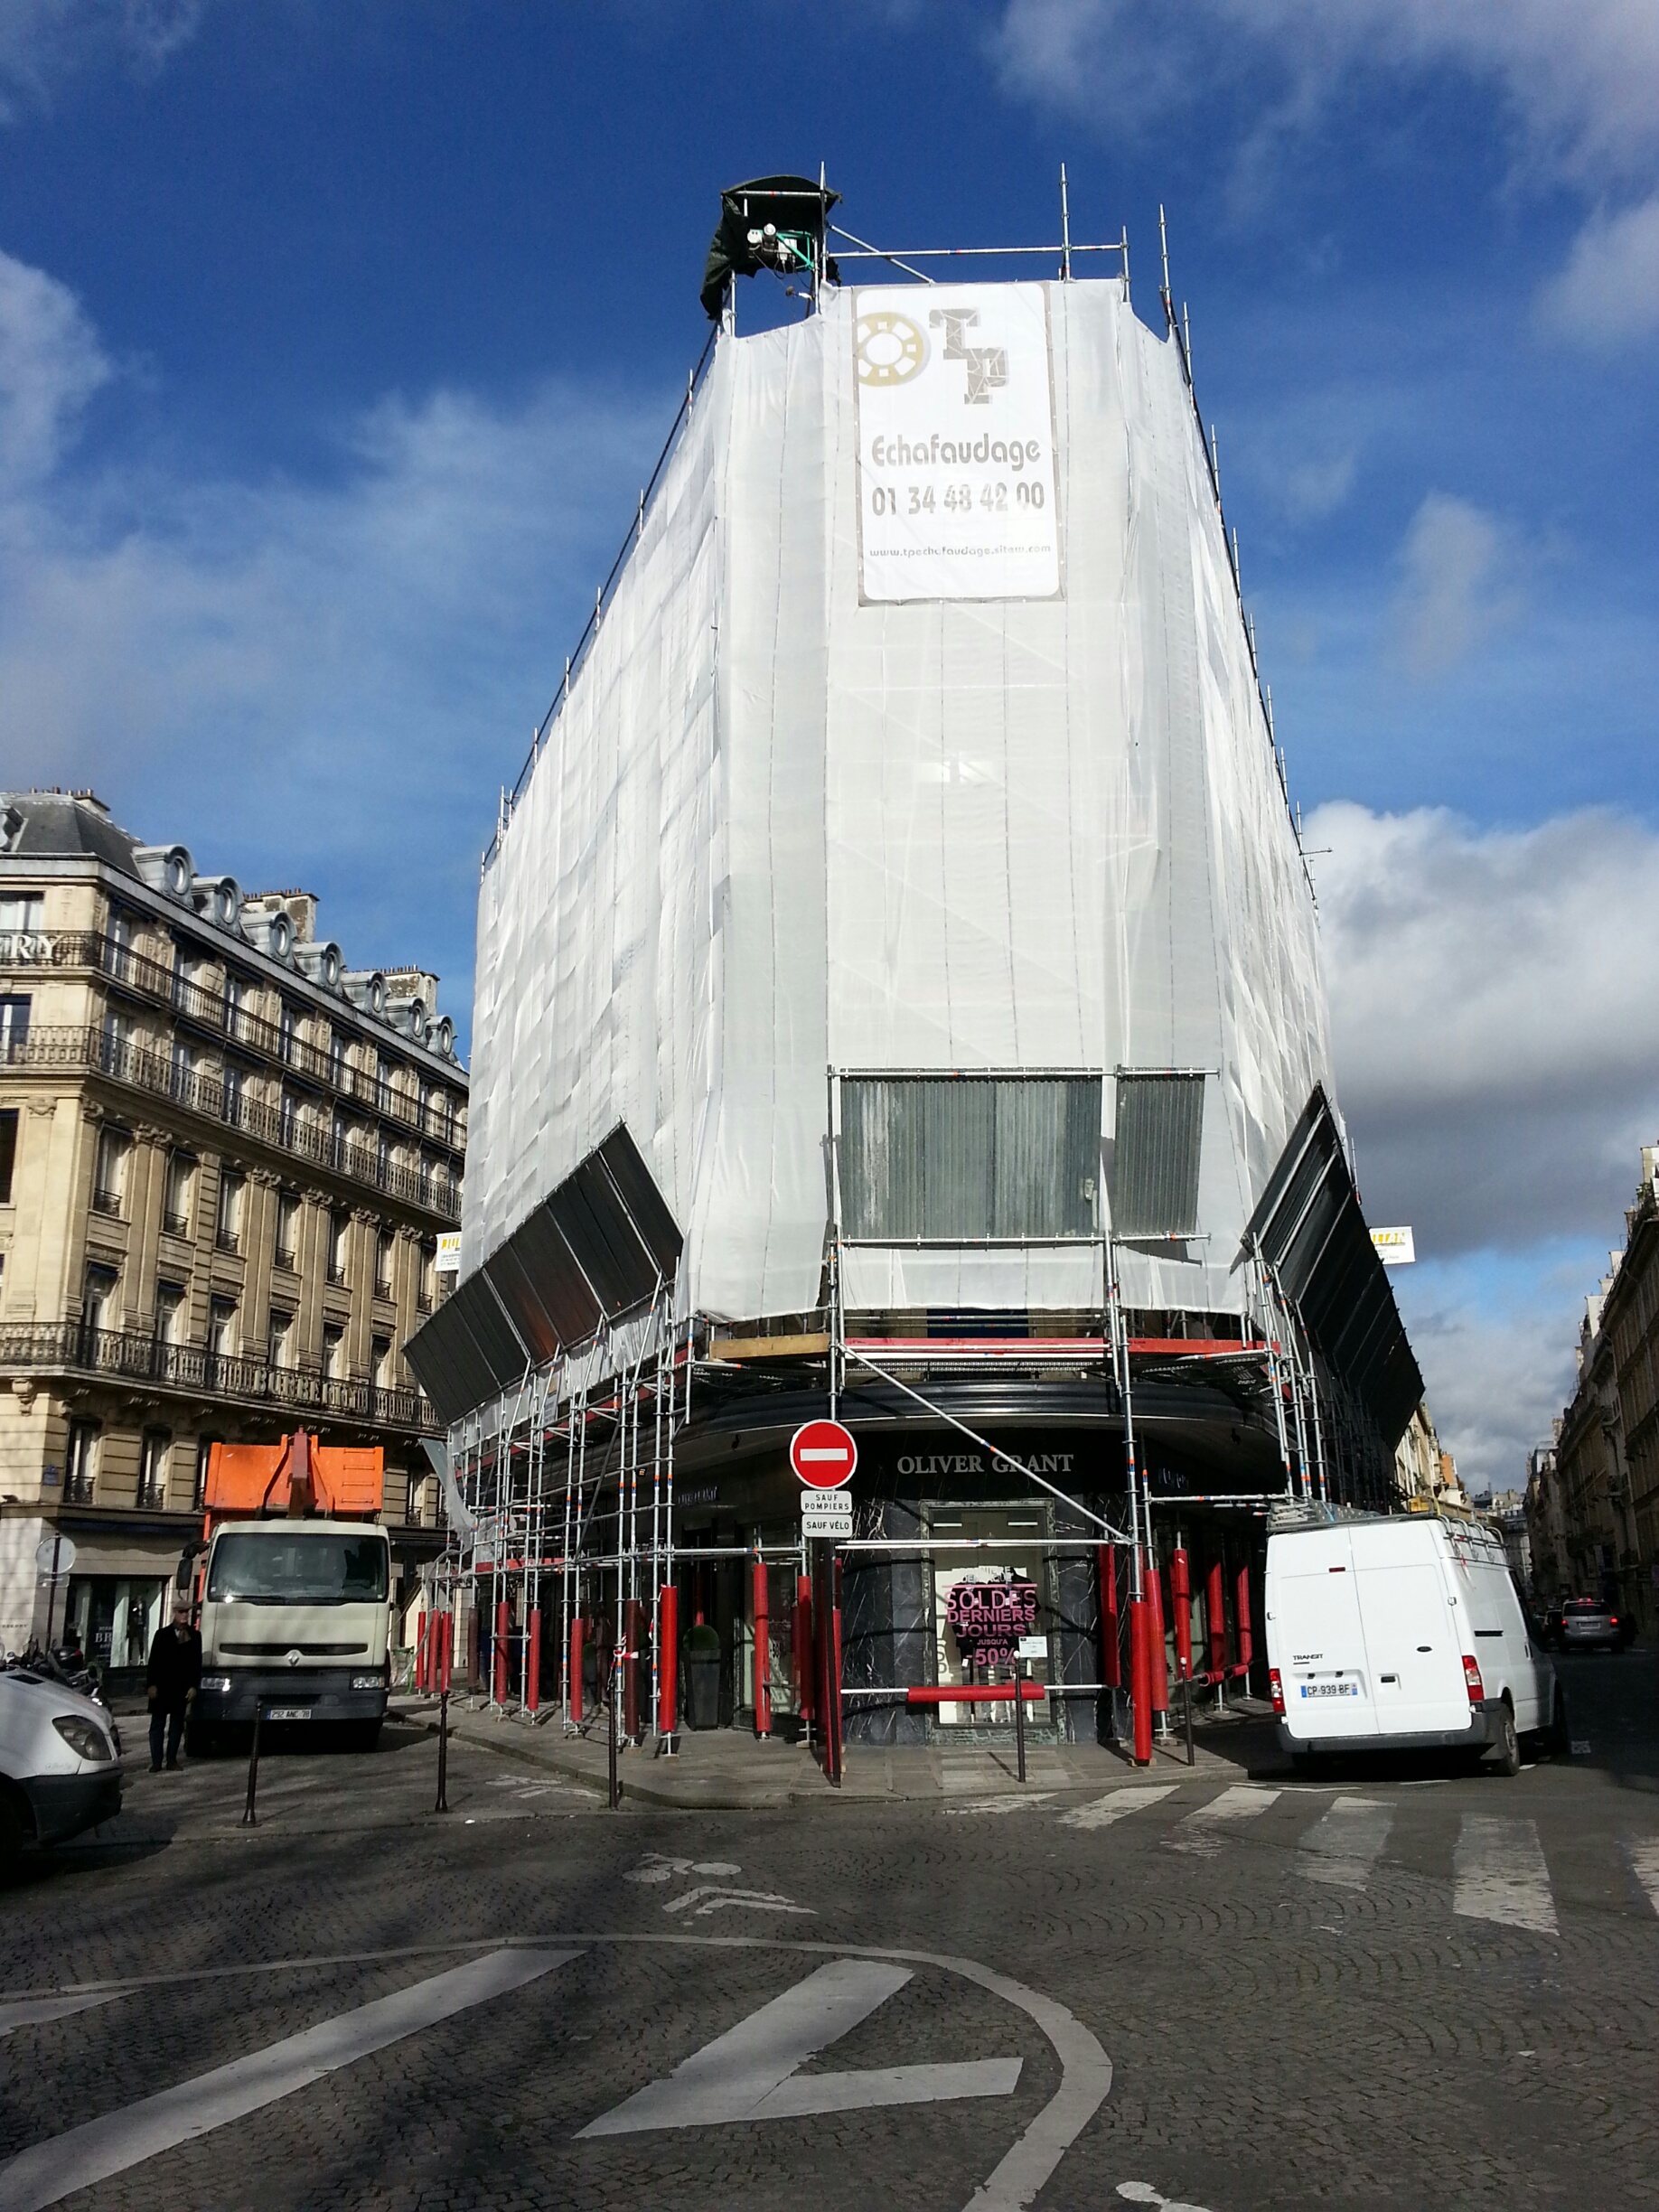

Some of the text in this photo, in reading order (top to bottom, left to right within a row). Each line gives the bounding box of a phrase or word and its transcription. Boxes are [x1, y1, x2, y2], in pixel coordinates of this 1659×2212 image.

[872, 433, 1041, 472] Echafaudage
[872, 482, 1045, 516] 01 34 48 42 00
[897, 1453, 1074, 1475] OLIVER GRANT
[804, 1503, 849, 1511] POMPIERS
[806, 1520, 849, 1530] SAUF VÉLO
[944, 1589, 1036, 1610] SOLDES
[946, 1608, 1036, 1623] DERNIERS
[955, 1624, 1027, 1638] JOURS
[966, 1647, 1017, 1666] -50%
[1292, 1653, 1324, 1661] TRANSIT
